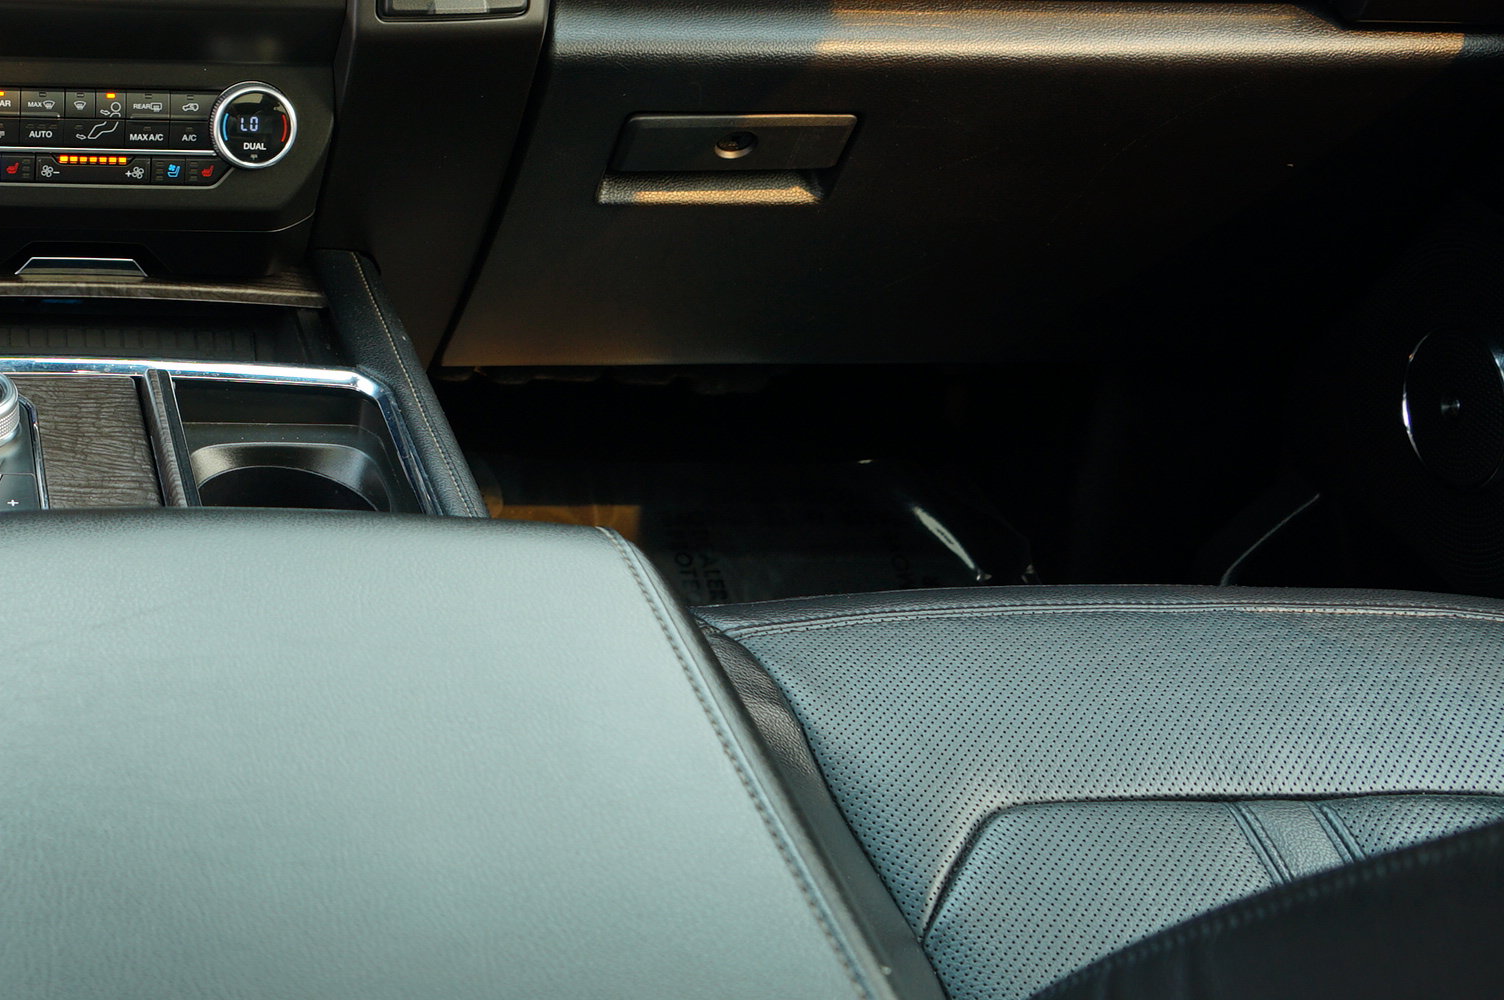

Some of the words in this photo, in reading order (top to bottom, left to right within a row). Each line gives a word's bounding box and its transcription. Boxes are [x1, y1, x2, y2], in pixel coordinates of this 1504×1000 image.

[27, 100, 43, 108] MAX
[133, 102, 152, 110] REAR
[28, 129, 53, 139] AUTO
[181, 133, 197, 143] A/C
[242, 141, 267, 152] DUAL
